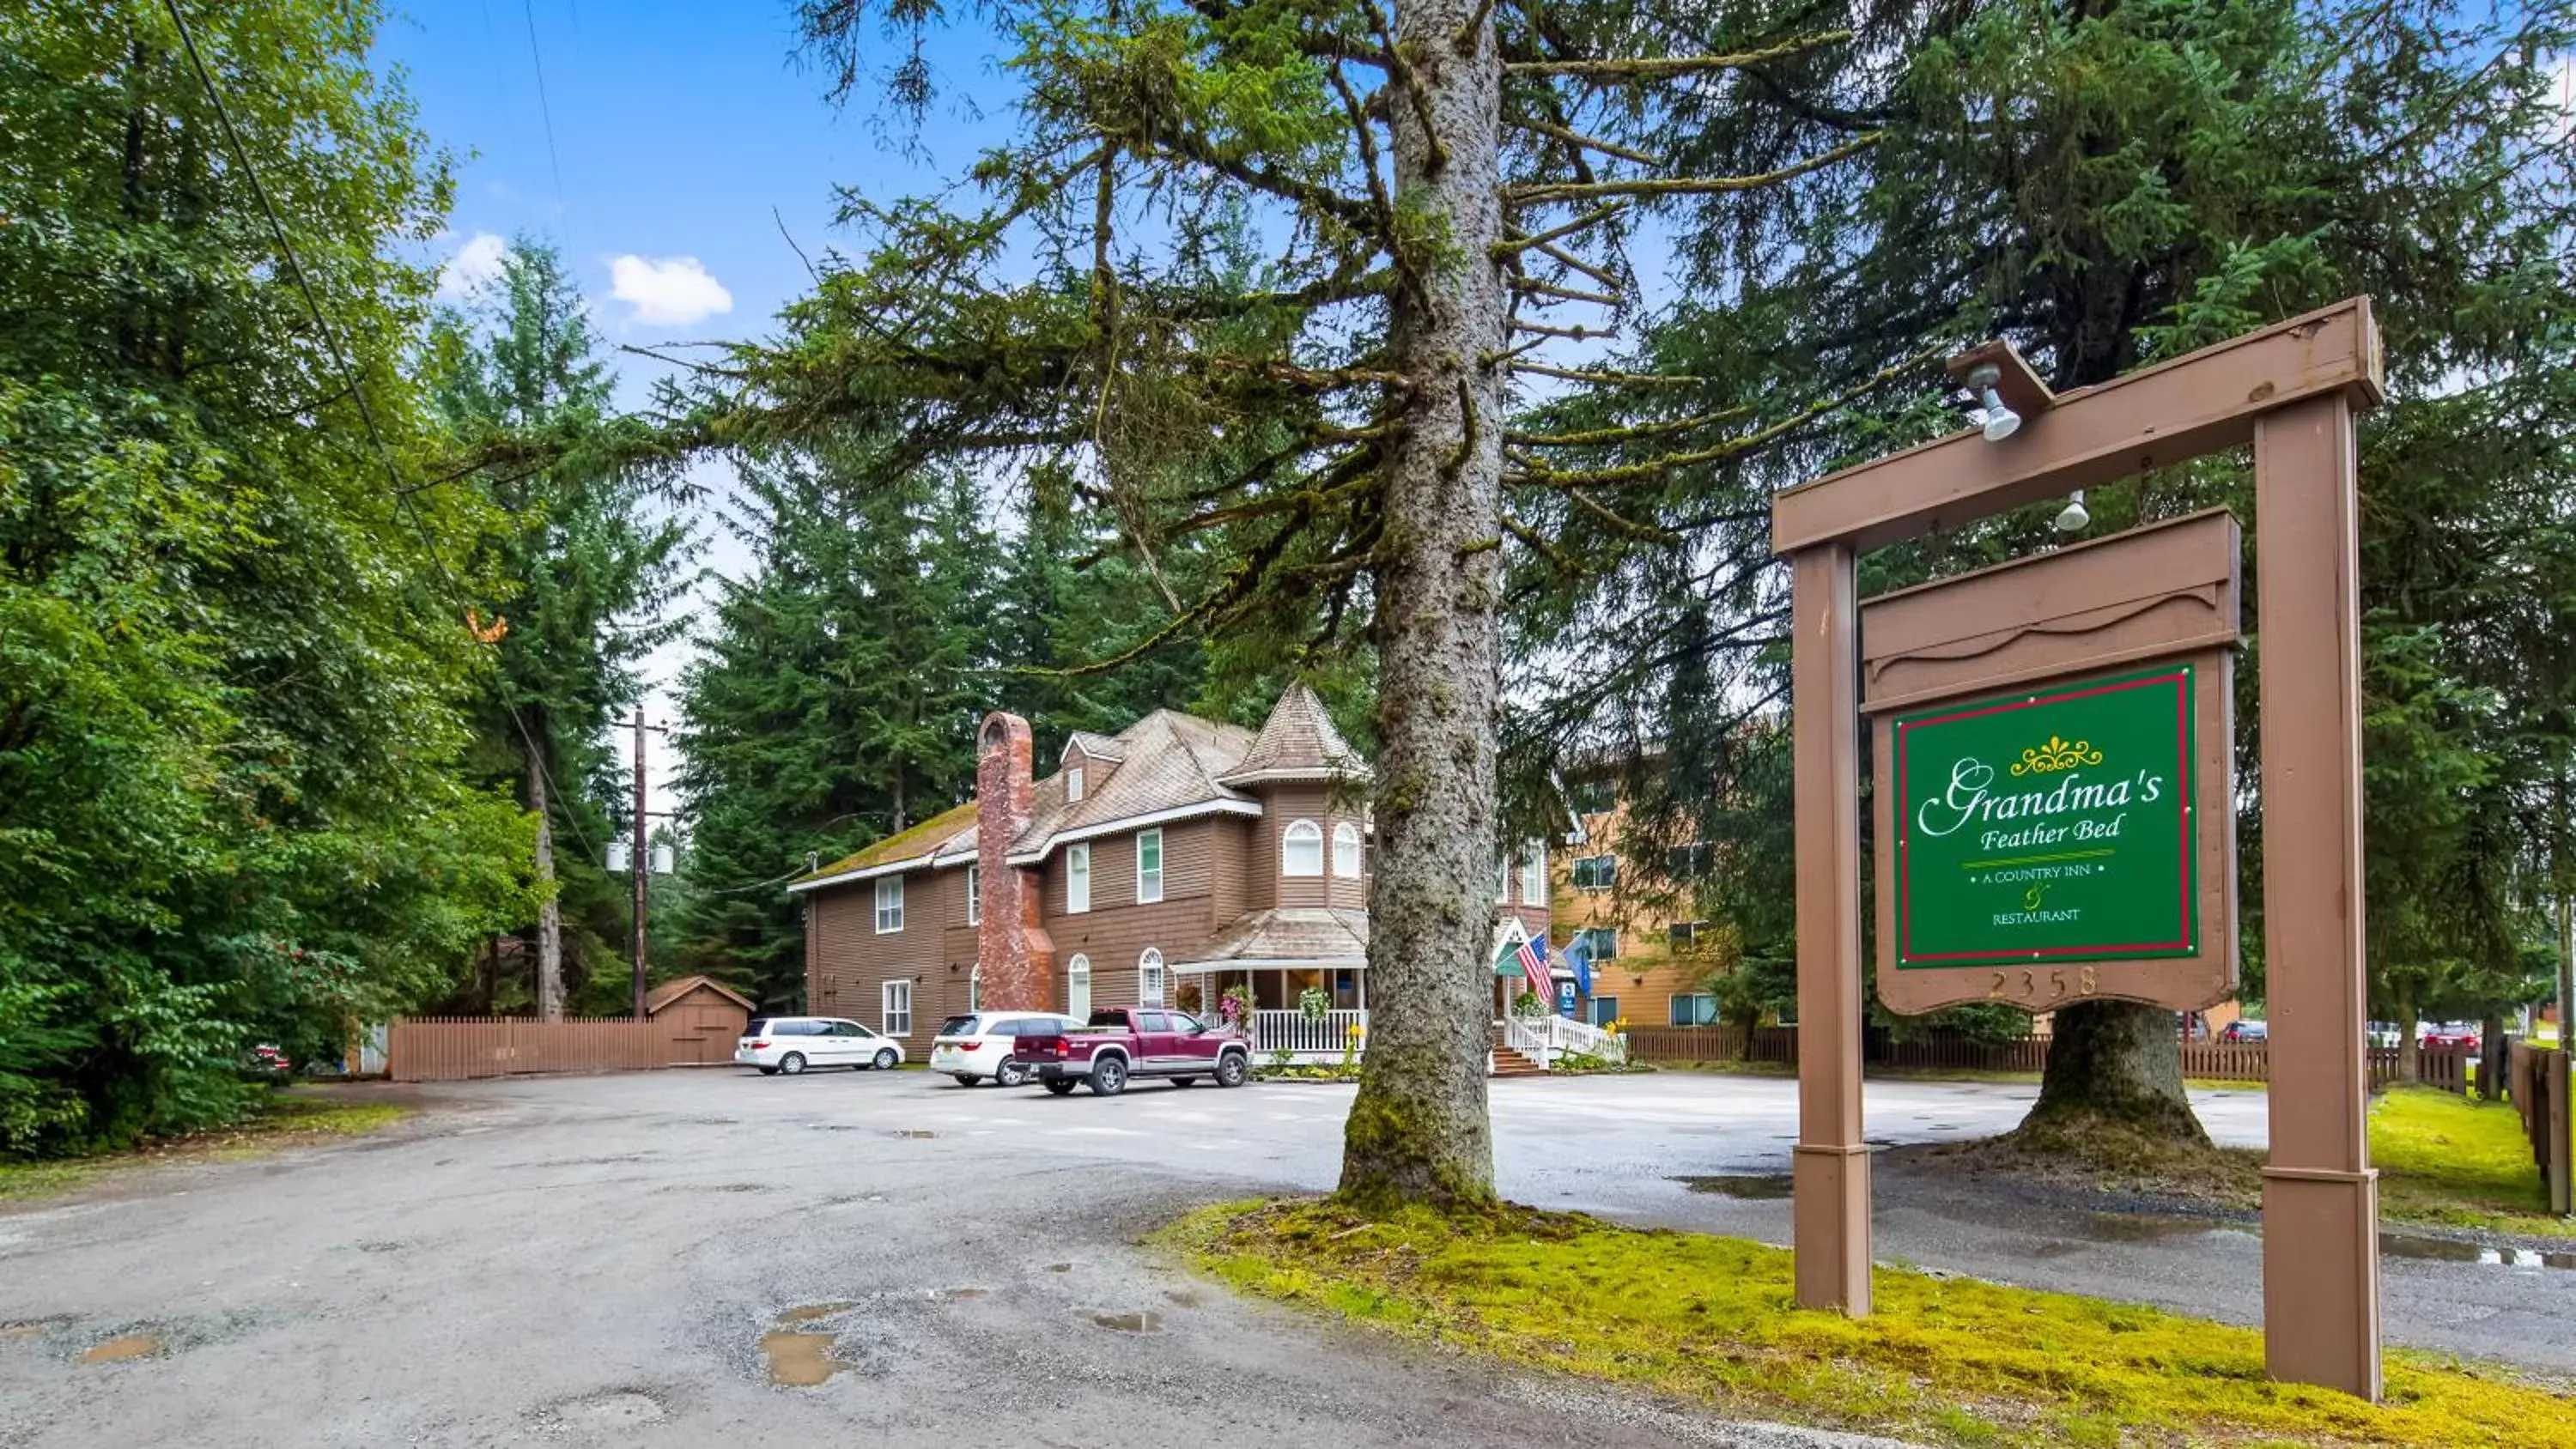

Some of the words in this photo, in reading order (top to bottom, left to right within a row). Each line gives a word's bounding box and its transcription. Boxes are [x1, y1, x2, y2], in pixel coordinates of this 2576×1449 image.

[1918, 757, 2163, 836] Grandma's
[1981, 822, 2069, 851] Feather
[2073, 813, 2127, 840] Bed
[1983, 872, 1992, 884] A
[1995, 867, 2062, 883] COUNTRY
[2064, 864, 2091, 876] INN
[1993, 909, 2081, 925] RESTAURANT
[1989, 966, 2096, 998] 2358
